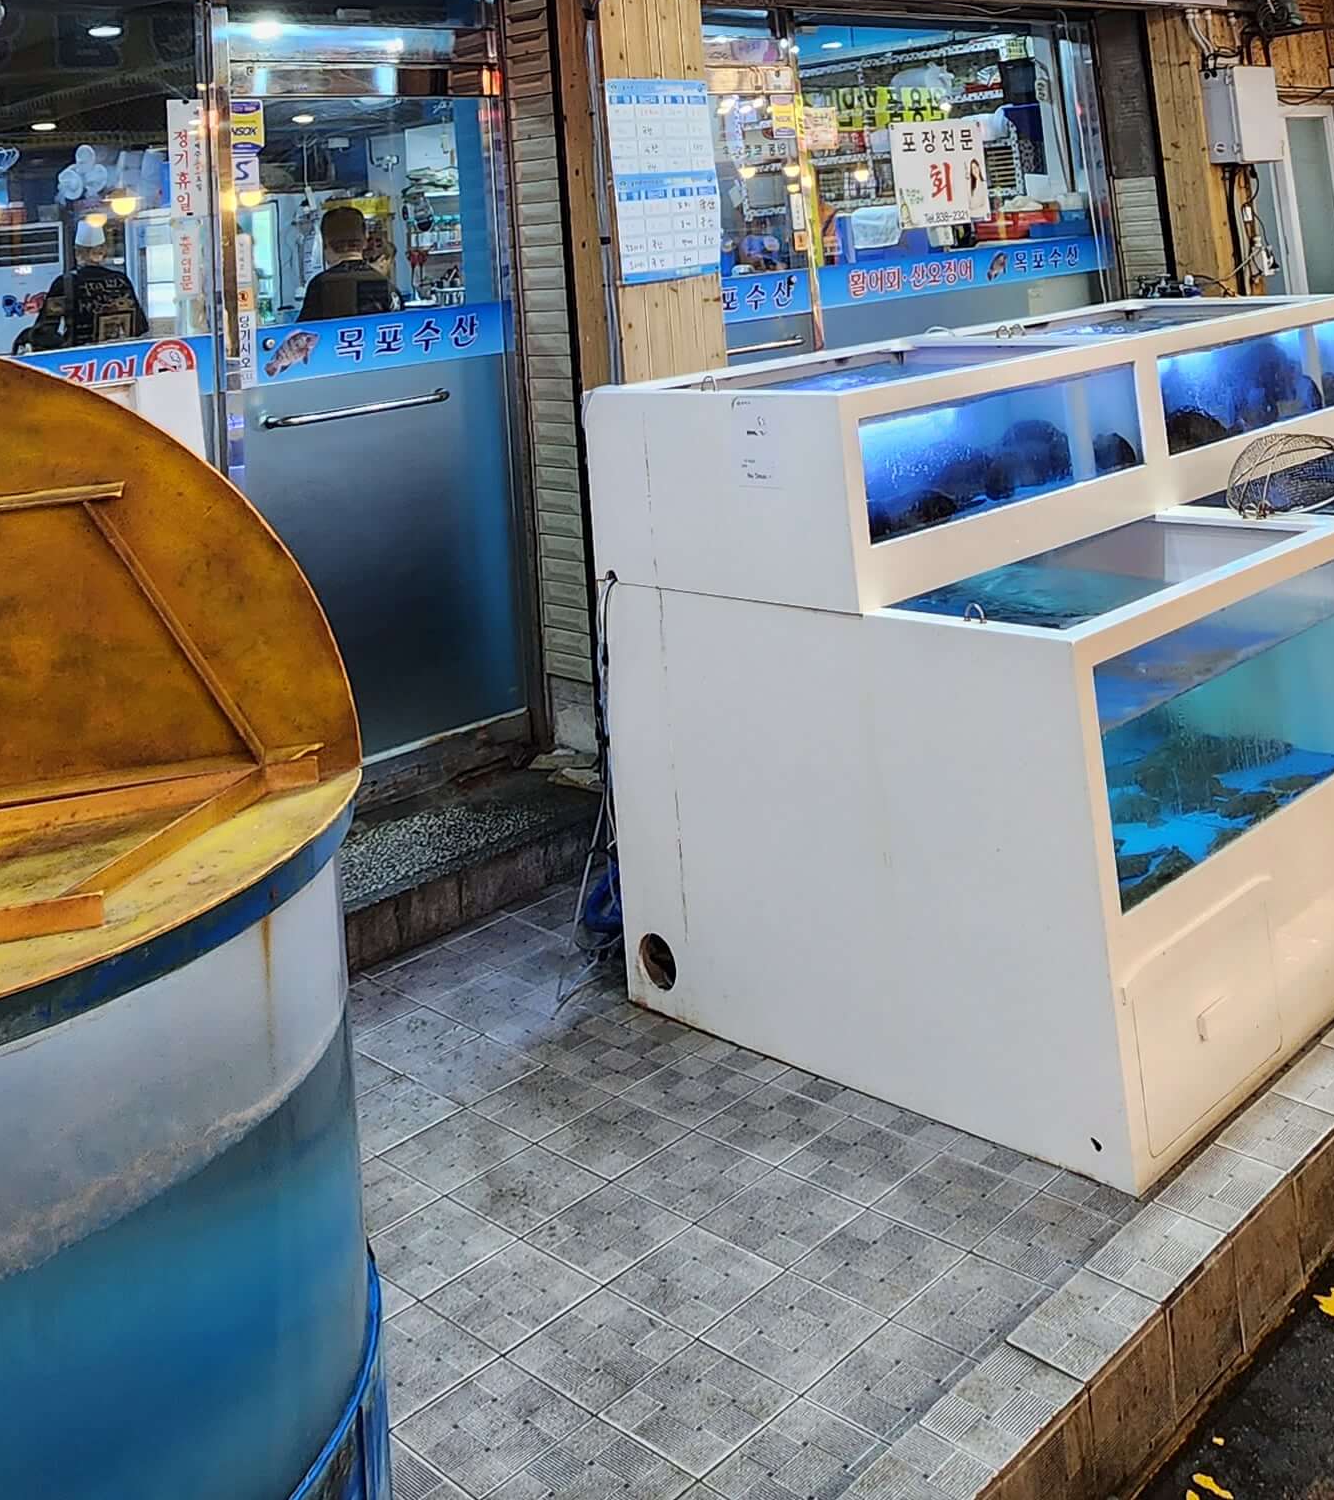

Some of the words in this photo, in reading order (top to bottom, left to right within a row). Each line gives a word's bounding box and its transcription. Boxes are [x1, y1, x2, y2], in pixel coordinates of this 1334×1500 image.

[902, 128, 974, 154] 포장전문
[173, 129, 192, 213] 정기휴일
[929, 162, 953, 203] 회
[1012, 251, 1080, 274] 목포수산
[239, 315, 252, 369] 당기시오
[334, 312, 480, 363] 목포수산
